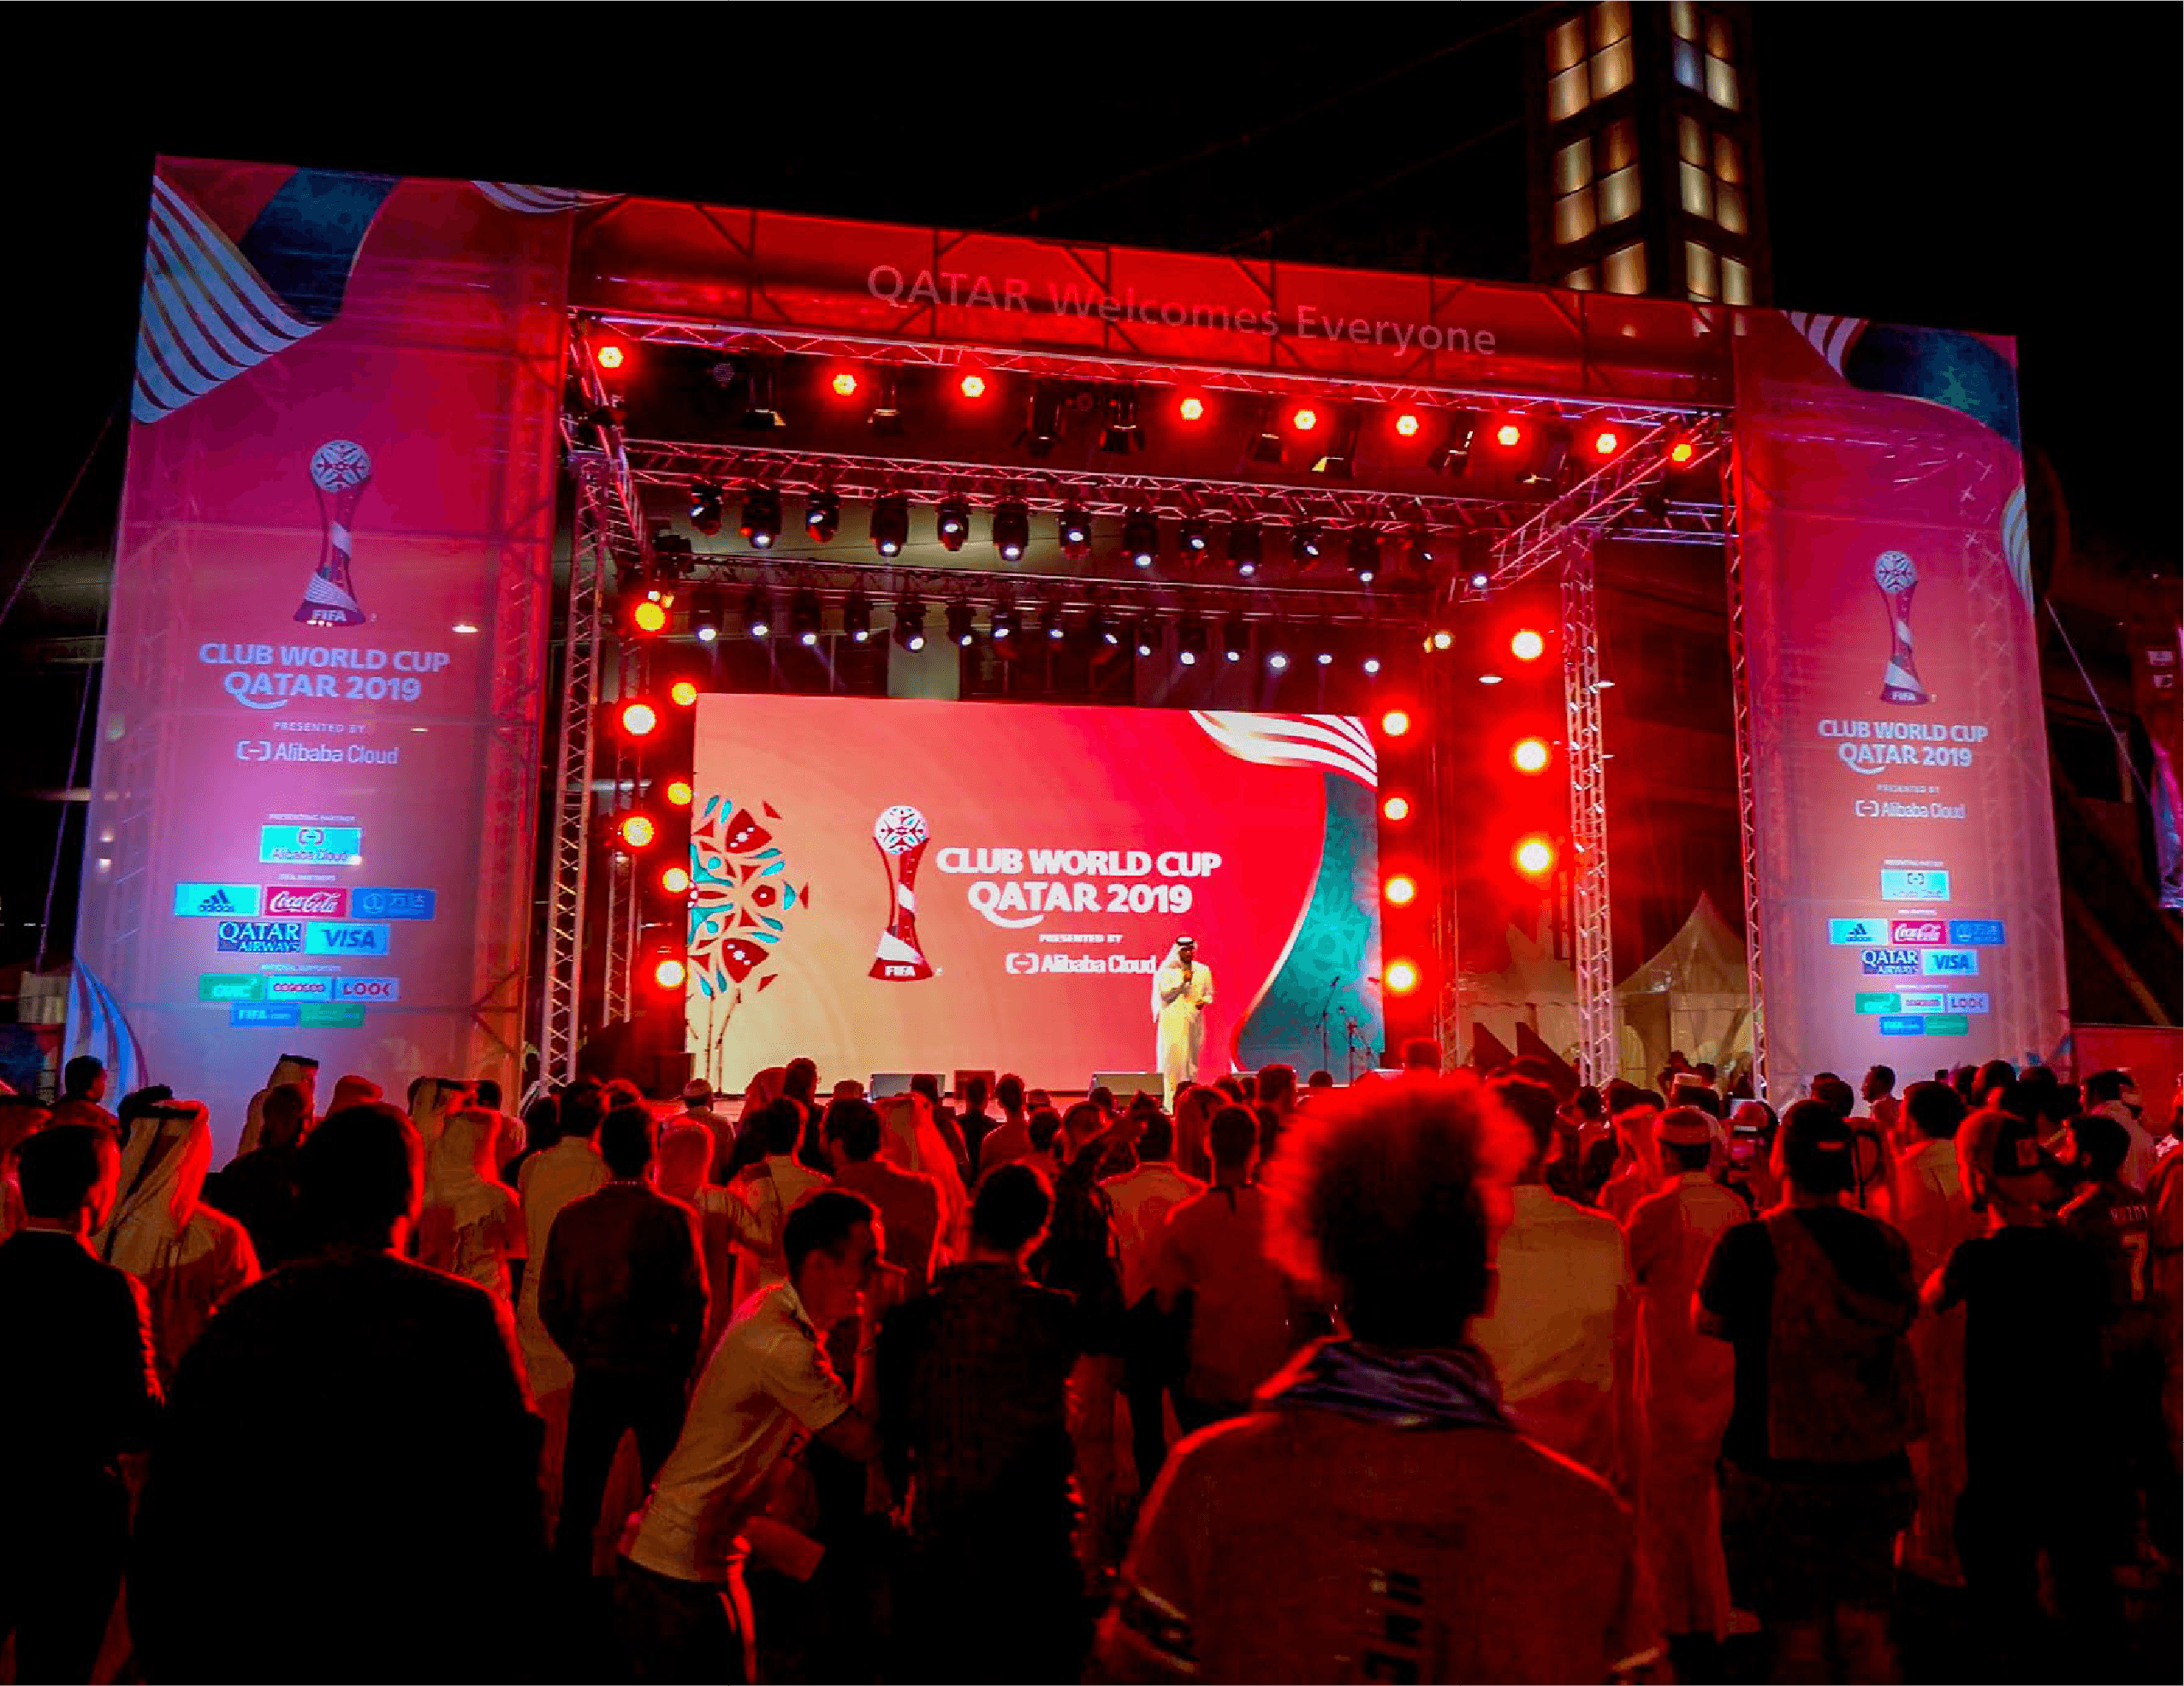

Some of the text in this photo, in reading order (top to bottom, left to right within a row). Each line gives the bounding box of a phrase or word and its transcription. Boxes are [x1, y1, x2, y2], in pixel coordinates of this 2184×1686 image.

[867, 264, 1497, 357] QATAR Welcomes Everyone
[312, 609, 347, 622] FIFA
[199, 643, 450, 673] CLUB WORLD CUP
[223, 671, 423, 709] QATAR 2019
[1818, 719, 1990, 743] CLUB WORLD CUP
[276, 741, 400, 765] Alibaba Cloud
[1837, 741, 1973, 775] QATAR 2019
[935, 847, 1223, 877] CLUB WORLD CUP
[967, 881, 1193, 929] QATAR 2019
[219, 922, 300, 943] QATAR
[321, 929, 377, 949] VISA
[240, 941, 301, 953] AIRWAYS
[1862, 949, 1919, 966] QATAR
[884, 965, 917, 977] FIFA
[1041, 953, 1157, 974] Alibaba Cloud
[1932, 954, 1970, 971] VISA
[2122, 1232, 2149, 1300] 7
